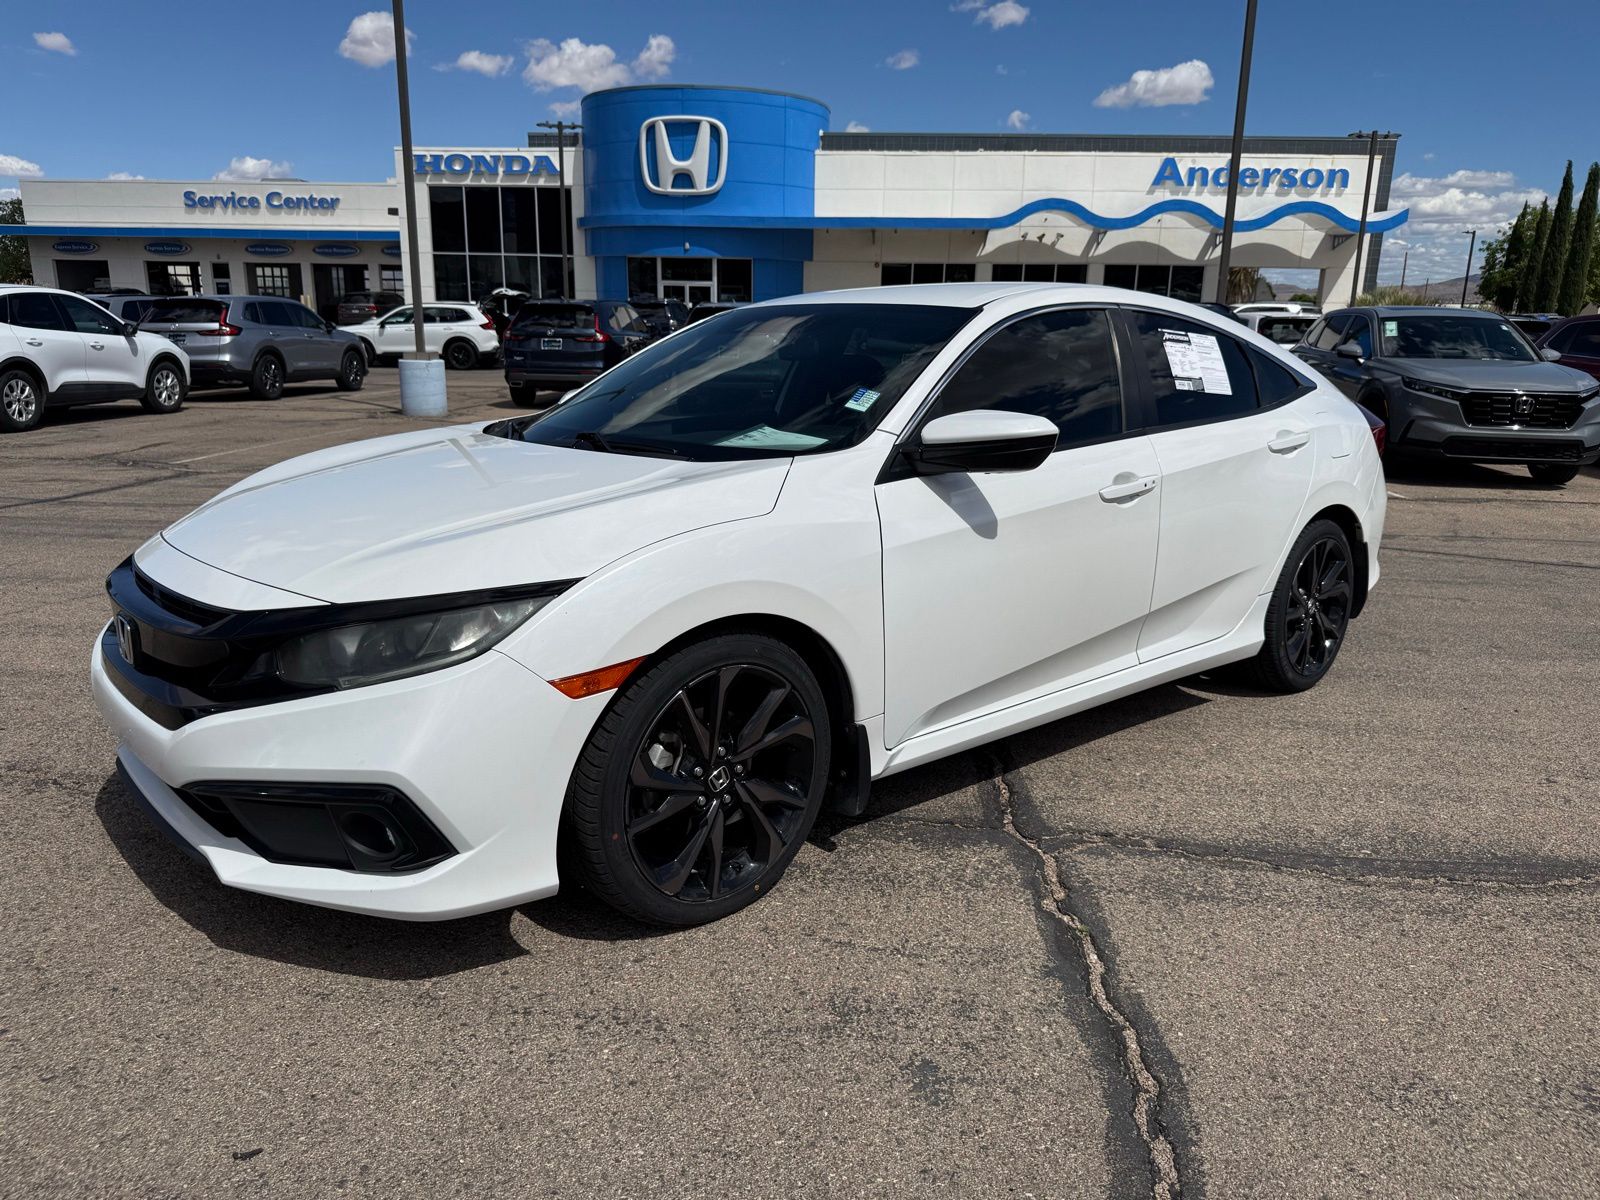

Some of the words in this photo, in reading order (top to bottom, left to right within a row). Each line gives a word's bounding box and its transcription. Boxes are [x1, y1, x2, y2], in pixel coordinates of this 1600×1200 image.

[413, 153, 560, 175] HONDA
[1151, 157, 1350, 189] Anderson
[183, 190, 261, 209] Service
[265, 191, 341, 210] Center
